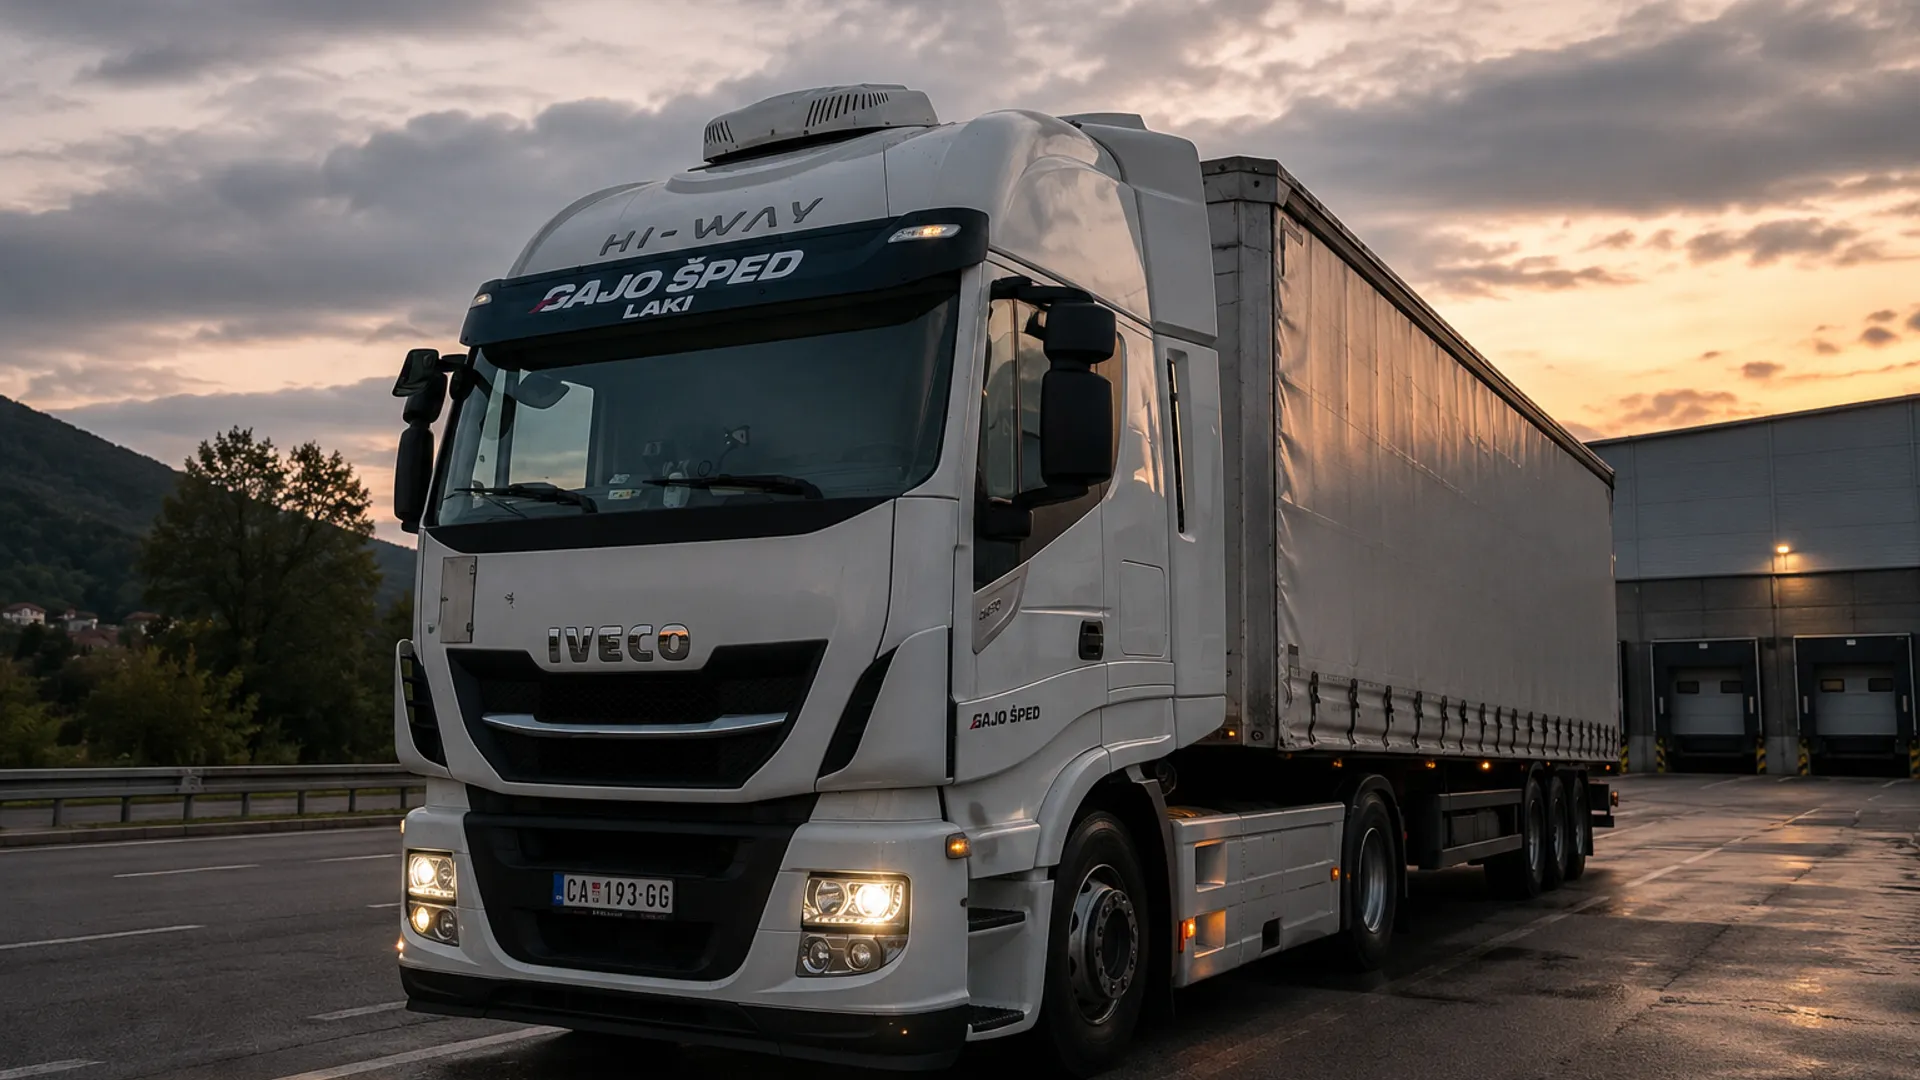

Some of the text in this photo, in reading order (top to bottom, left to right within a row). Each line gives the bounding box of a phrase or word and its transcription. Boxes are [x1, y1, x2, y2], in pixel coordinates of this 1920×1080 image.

[530, 249, 803, 313] GAJO ŠPED
[622, 295, 693, 319] LAKI
[548, 623, 690, 663] IVECO
[1010, 705, 1040, 723] ŠPED
[567, 879, 588, 903] CA
